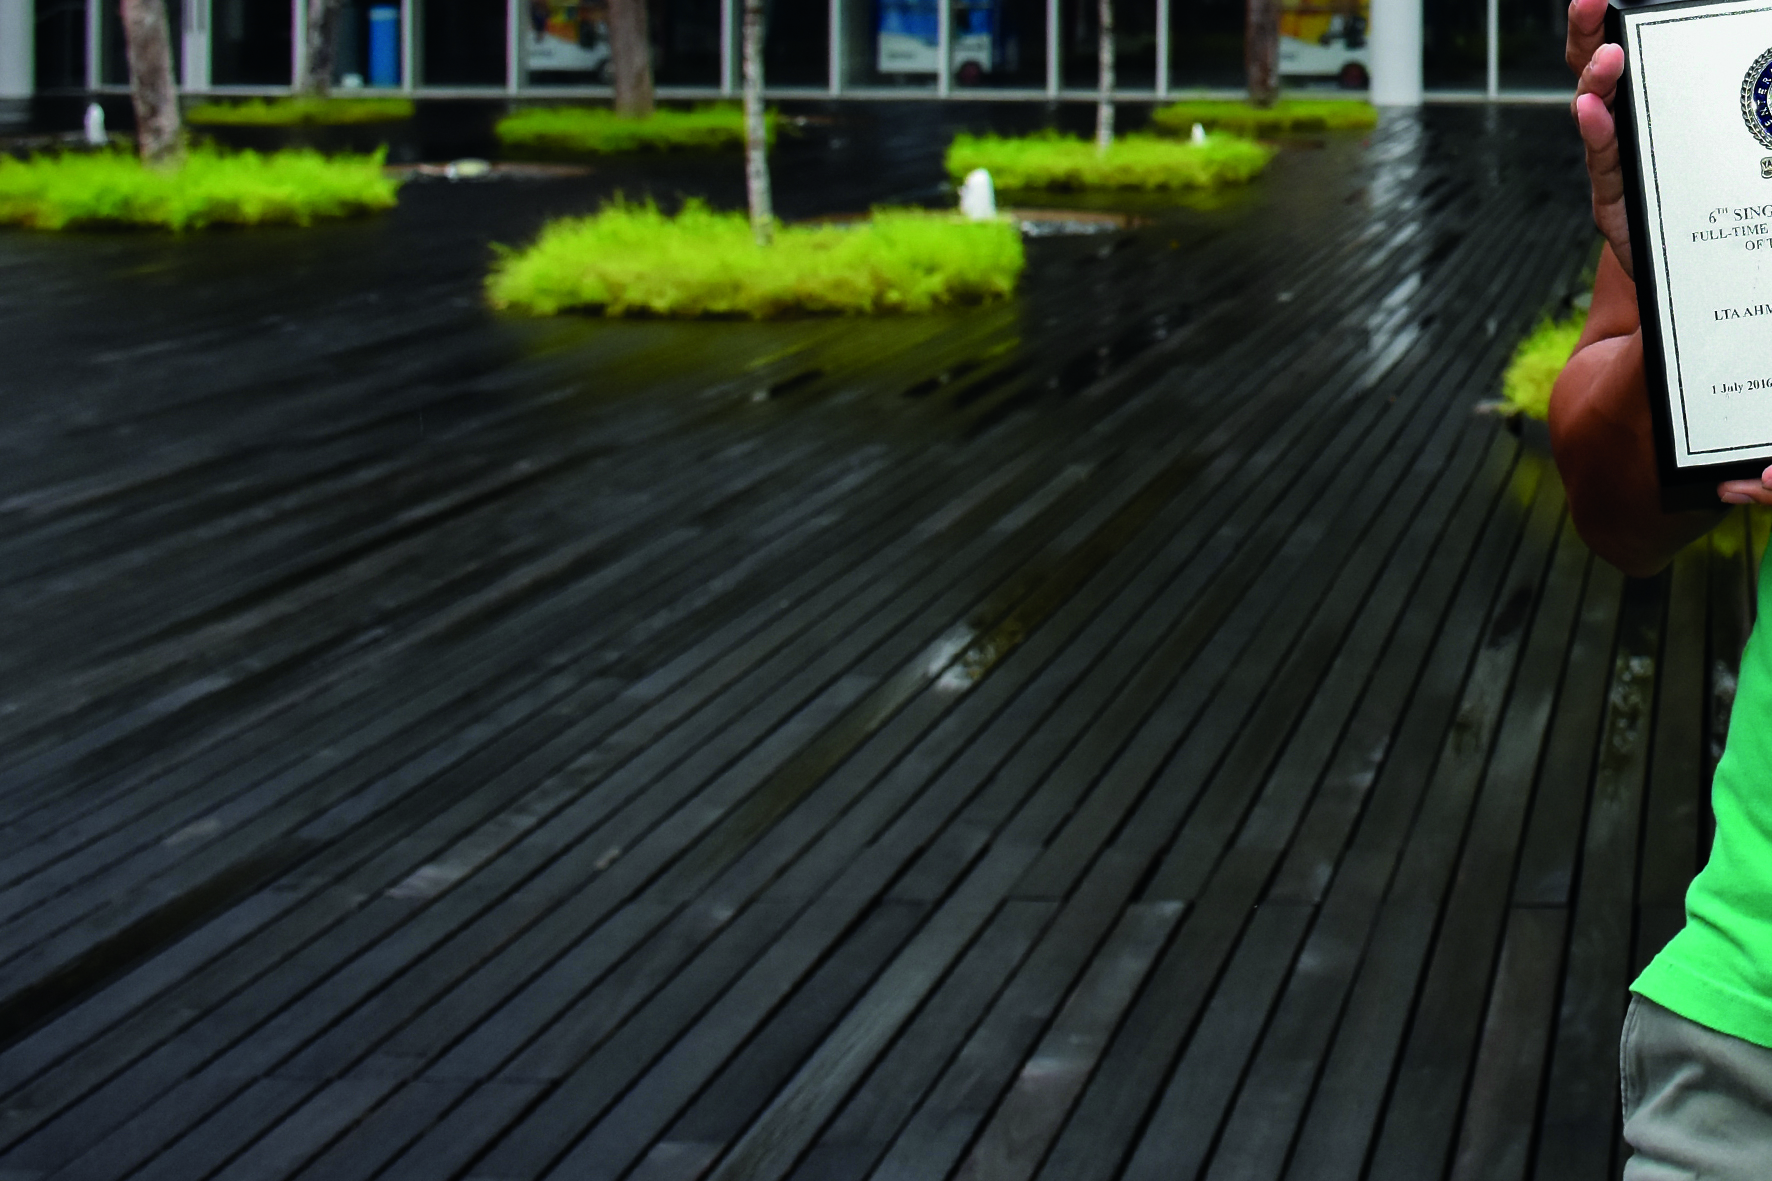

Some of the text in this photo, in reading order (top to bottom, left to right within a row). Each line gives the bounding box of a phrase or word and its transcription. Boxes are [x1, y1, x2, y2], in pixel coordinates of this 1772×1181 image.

[1691, 223, 1768, 242] FULL-TIME
[1745, 239, 1764, 251] OF
[1714, 308, 1740, 321] LTA
[1712, 377, 1772, 395] 1 July 2016
